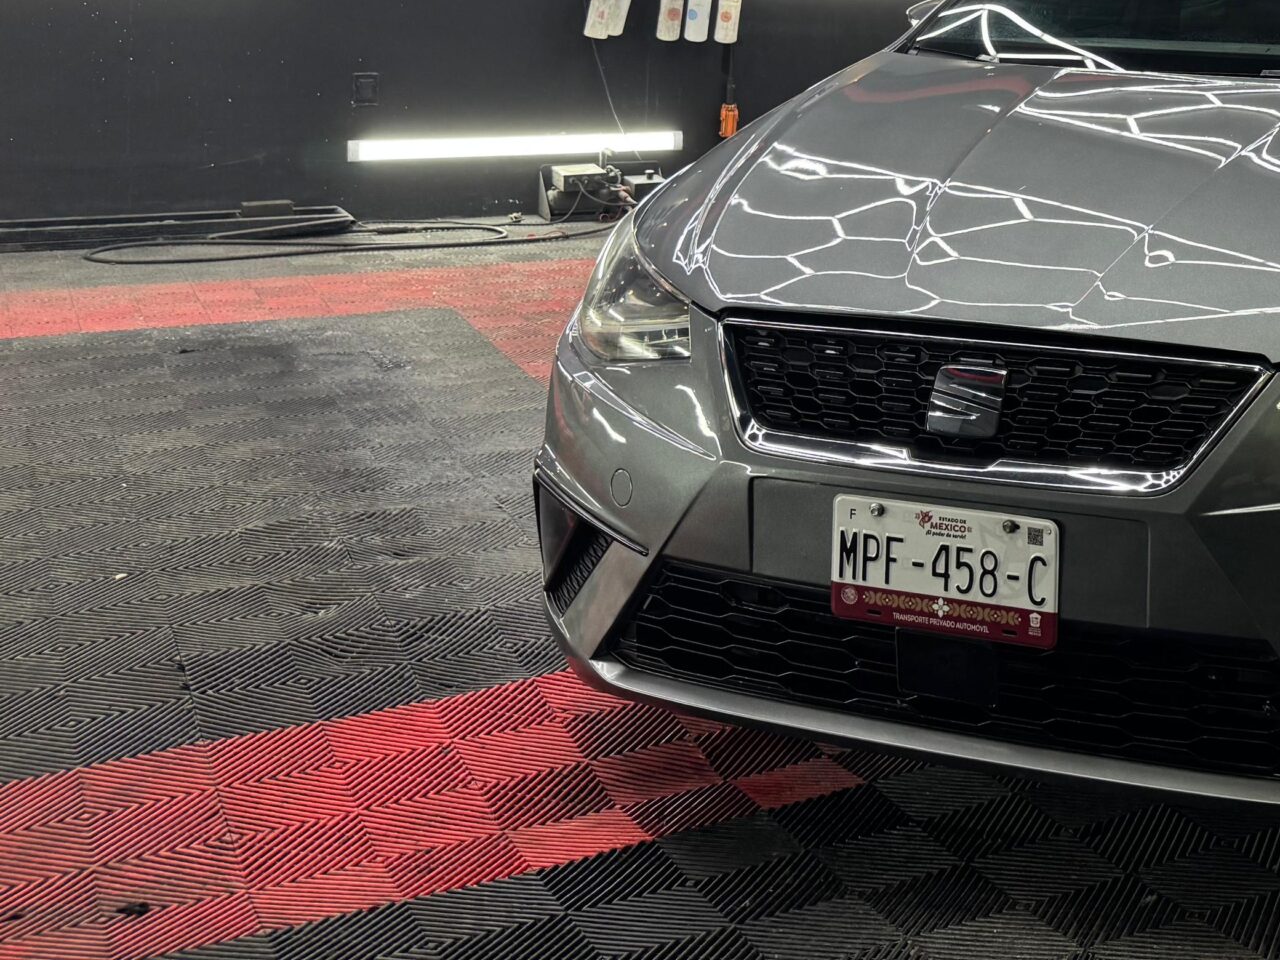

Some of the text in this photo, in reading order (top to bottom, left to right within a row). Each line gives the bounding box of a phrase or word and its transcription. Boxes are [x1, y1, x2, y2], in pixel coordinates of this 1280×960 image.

[849, 508, 857, 520] F
[938, 516, 959, 524] ESTADO
[838, 528, 1049, 607] MPF-458-C
[892, 612, 929, 625] TRANSPORTE
[929, 617, 956, 629] PRIVADO
